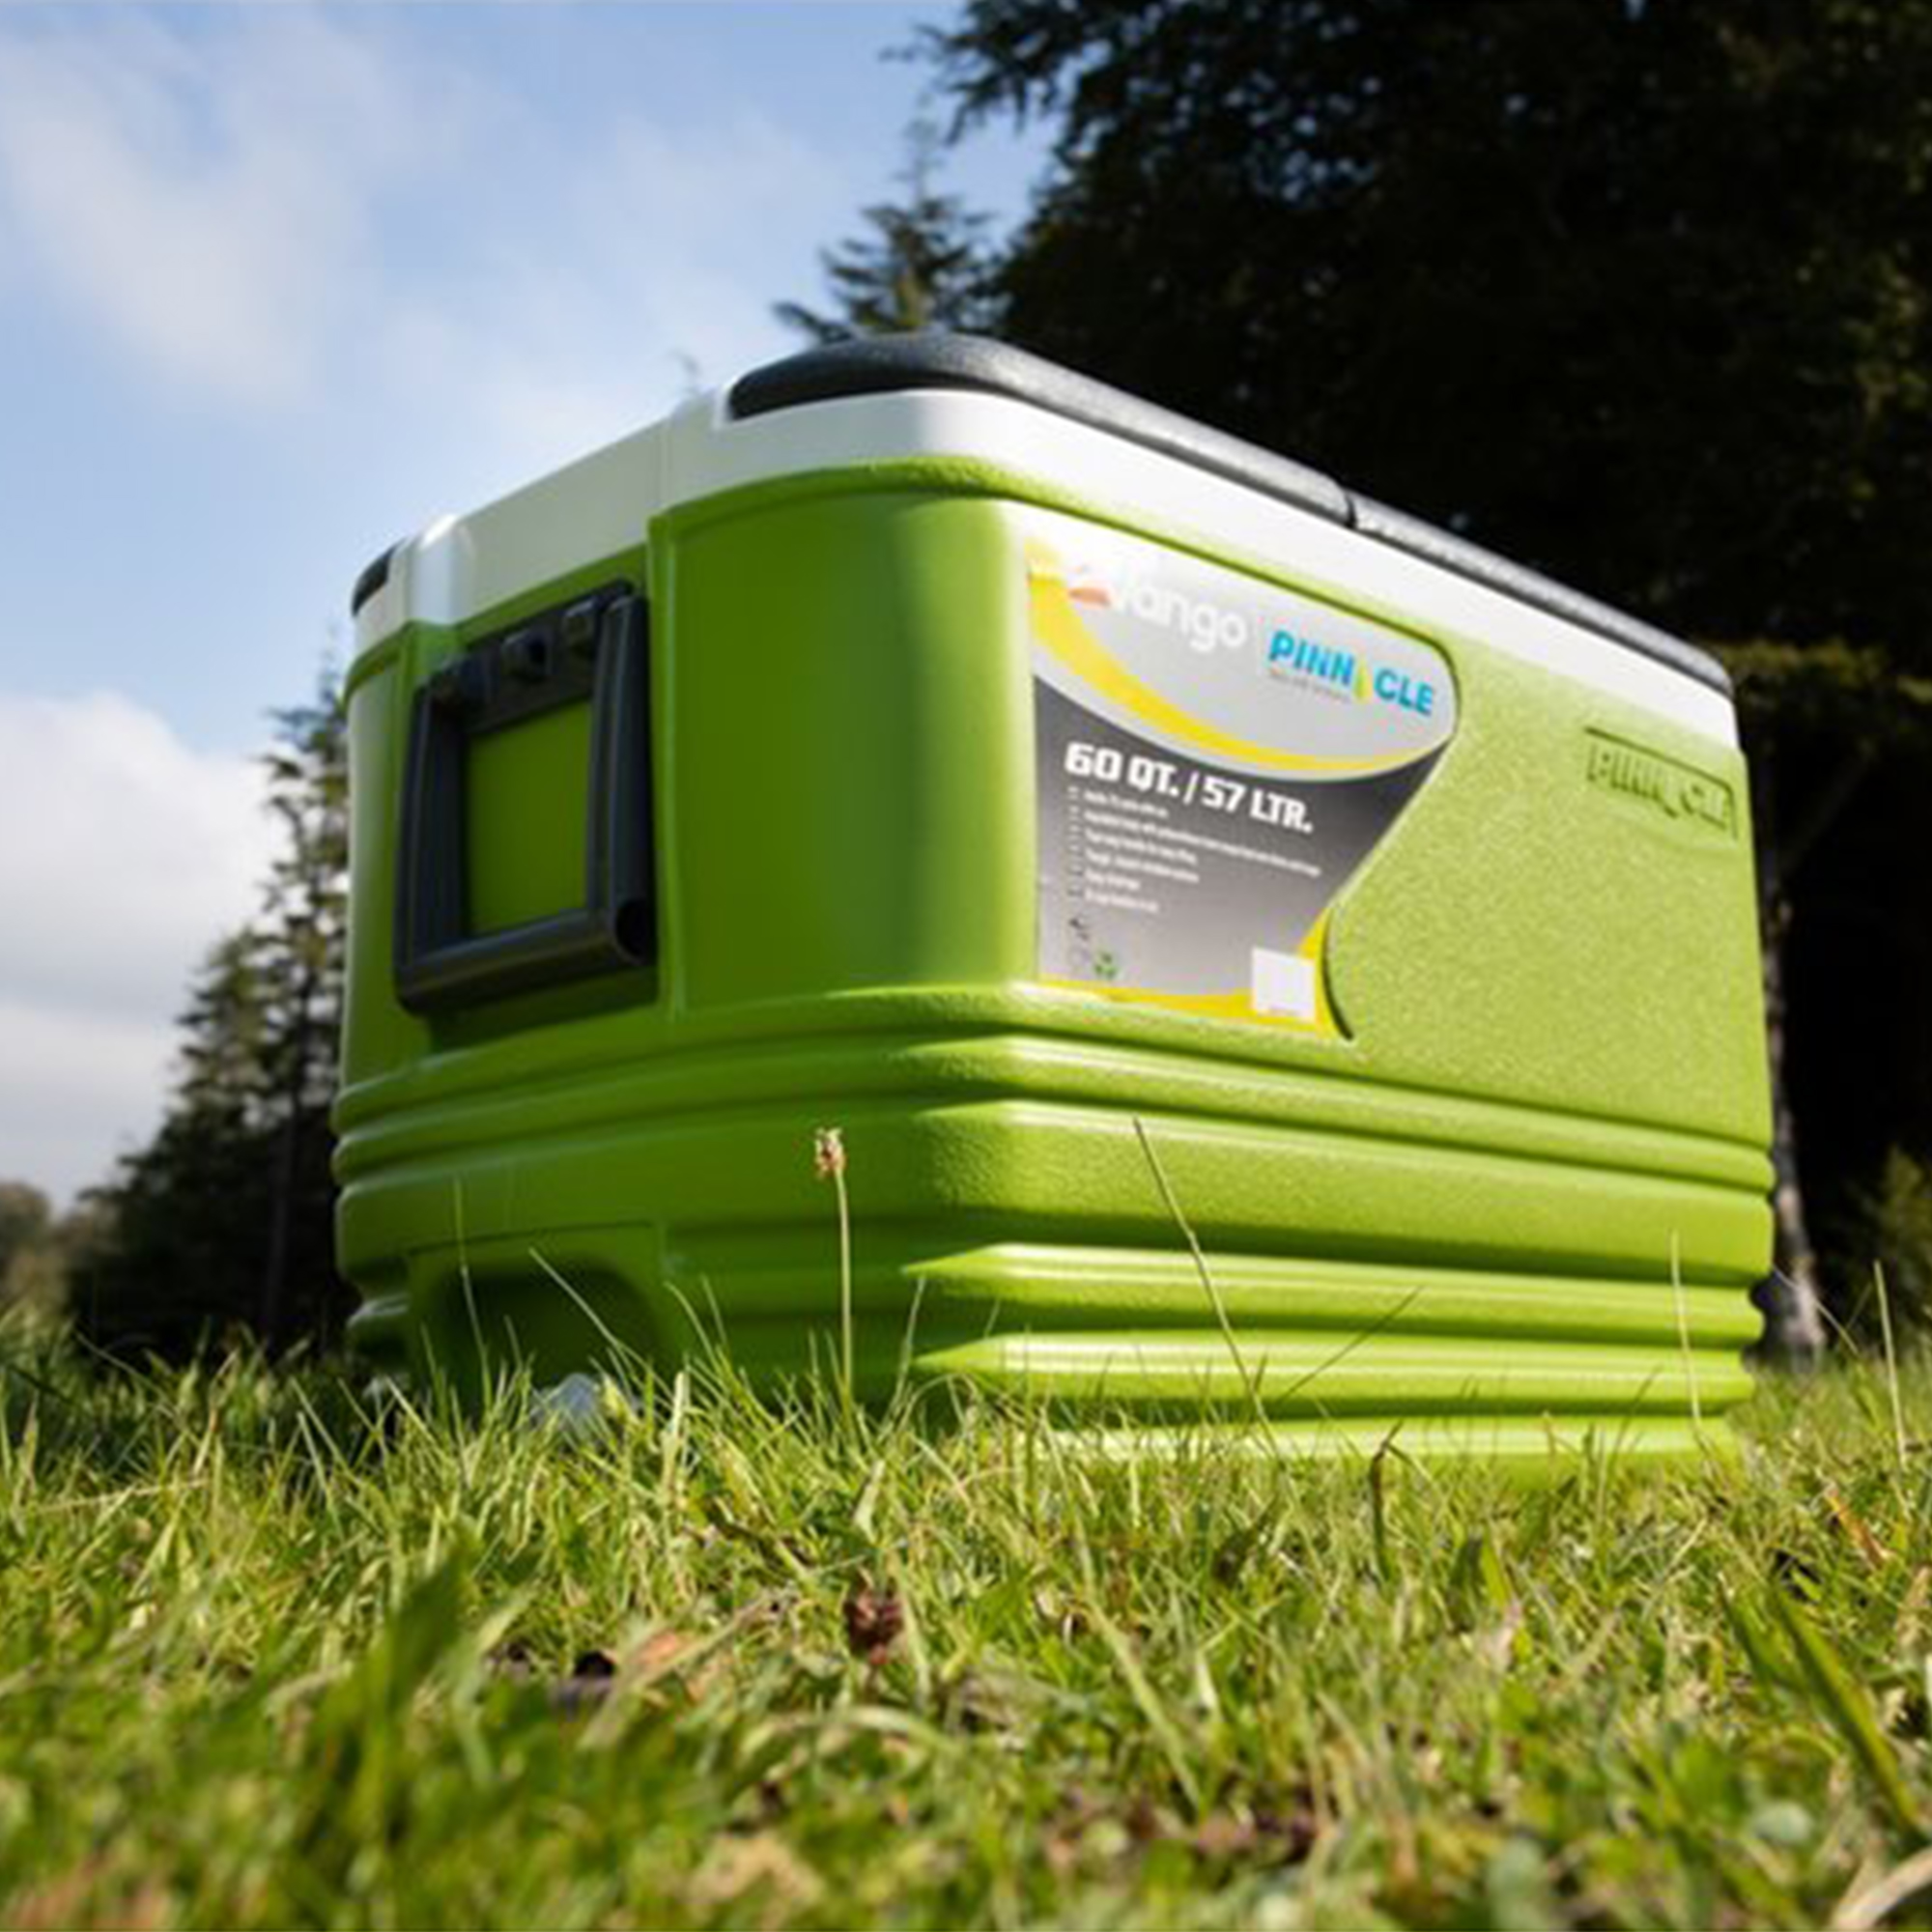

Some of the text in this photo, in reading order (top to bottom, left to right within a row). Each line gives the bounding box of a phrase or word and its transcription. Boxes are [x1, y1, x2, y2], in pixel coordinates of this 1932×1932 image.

[1065, 741, 1123, 782] 60
[1127, 755, 1179, 797] QT.
[1183, 771, 1200, 805] /
[1201, 775, 1247, 812] 57
[1250, 787, 1314, 834] LTR.
